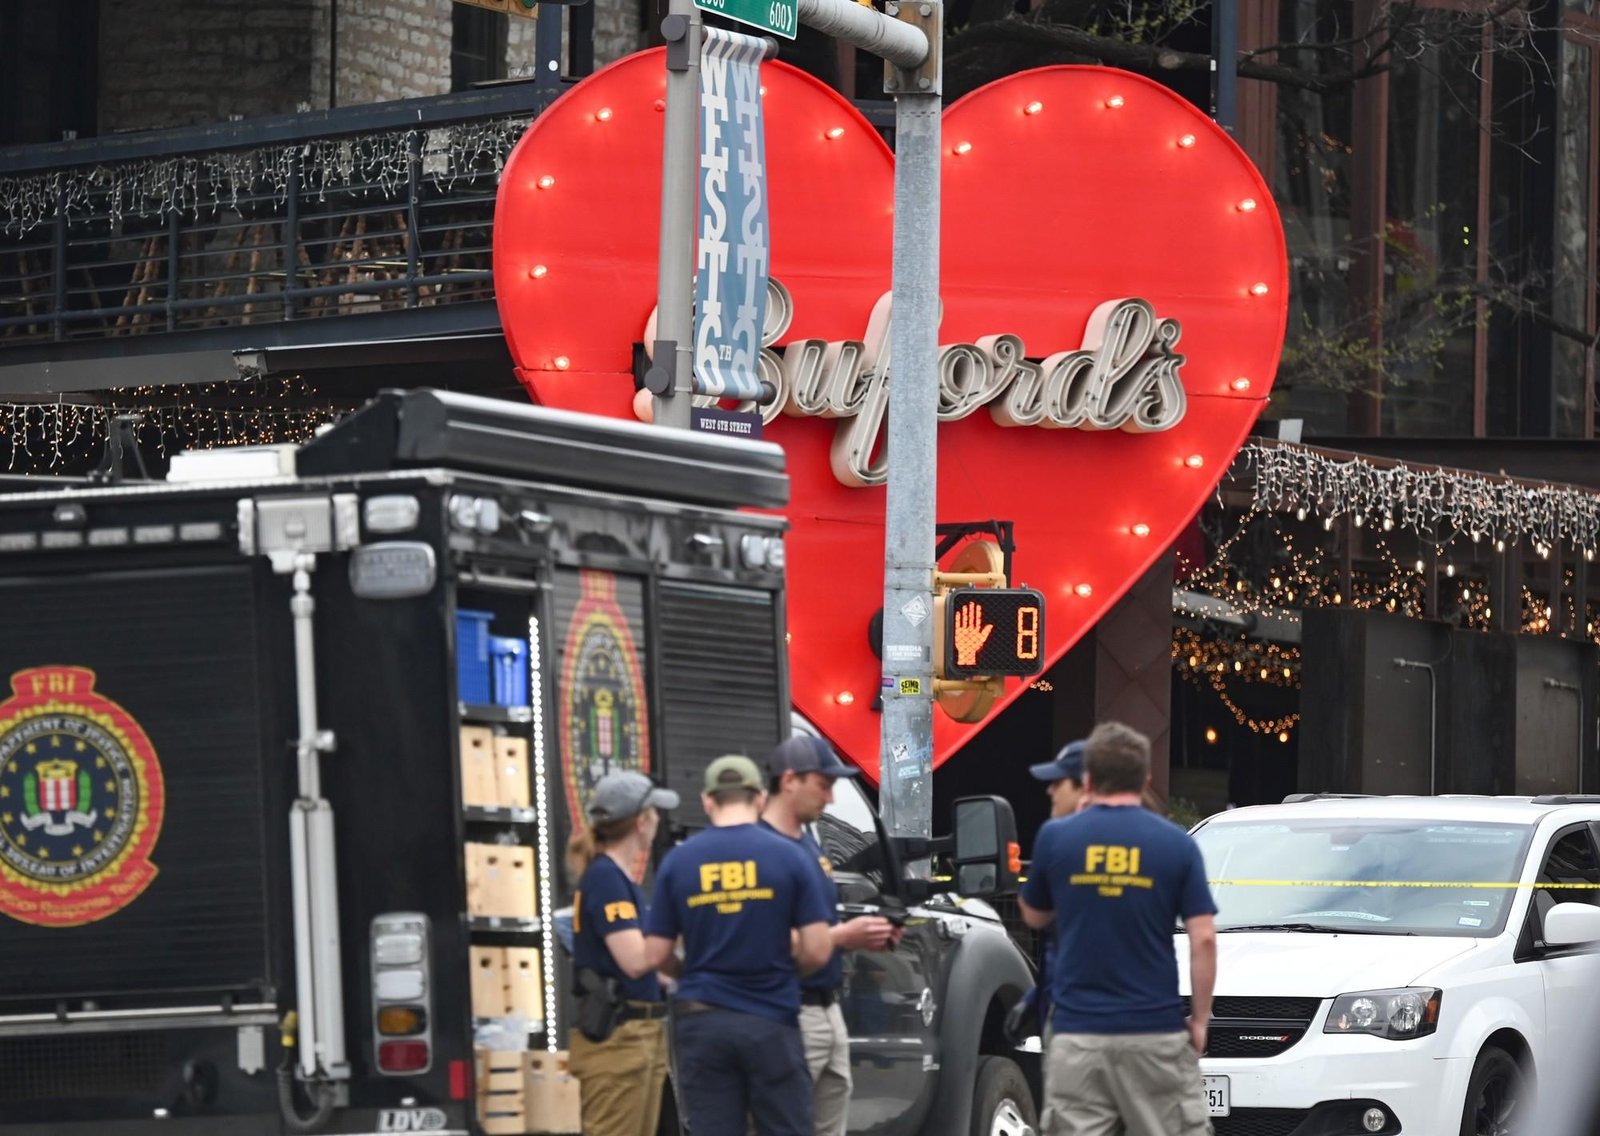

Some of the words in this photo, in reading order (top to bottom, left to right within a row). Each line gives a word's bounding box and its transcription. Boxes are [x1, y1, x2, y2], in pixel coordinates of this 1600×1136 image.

[769, 1, 787, 30] 600
[699, 27, 729, 317] WEST
[700, 418, 716, 430] WEST
[717, 420, 729, 432] 6TH
[729, 421, 752, 434] STREET
[32, 673, 76, 696] FBI
[1085, 845, 1140, 875] FBI
[700, 860, 757, 892] FBI
[1203, 1090, 1224, 1107] 51
[379, 1109, 426, 1132] LDV
